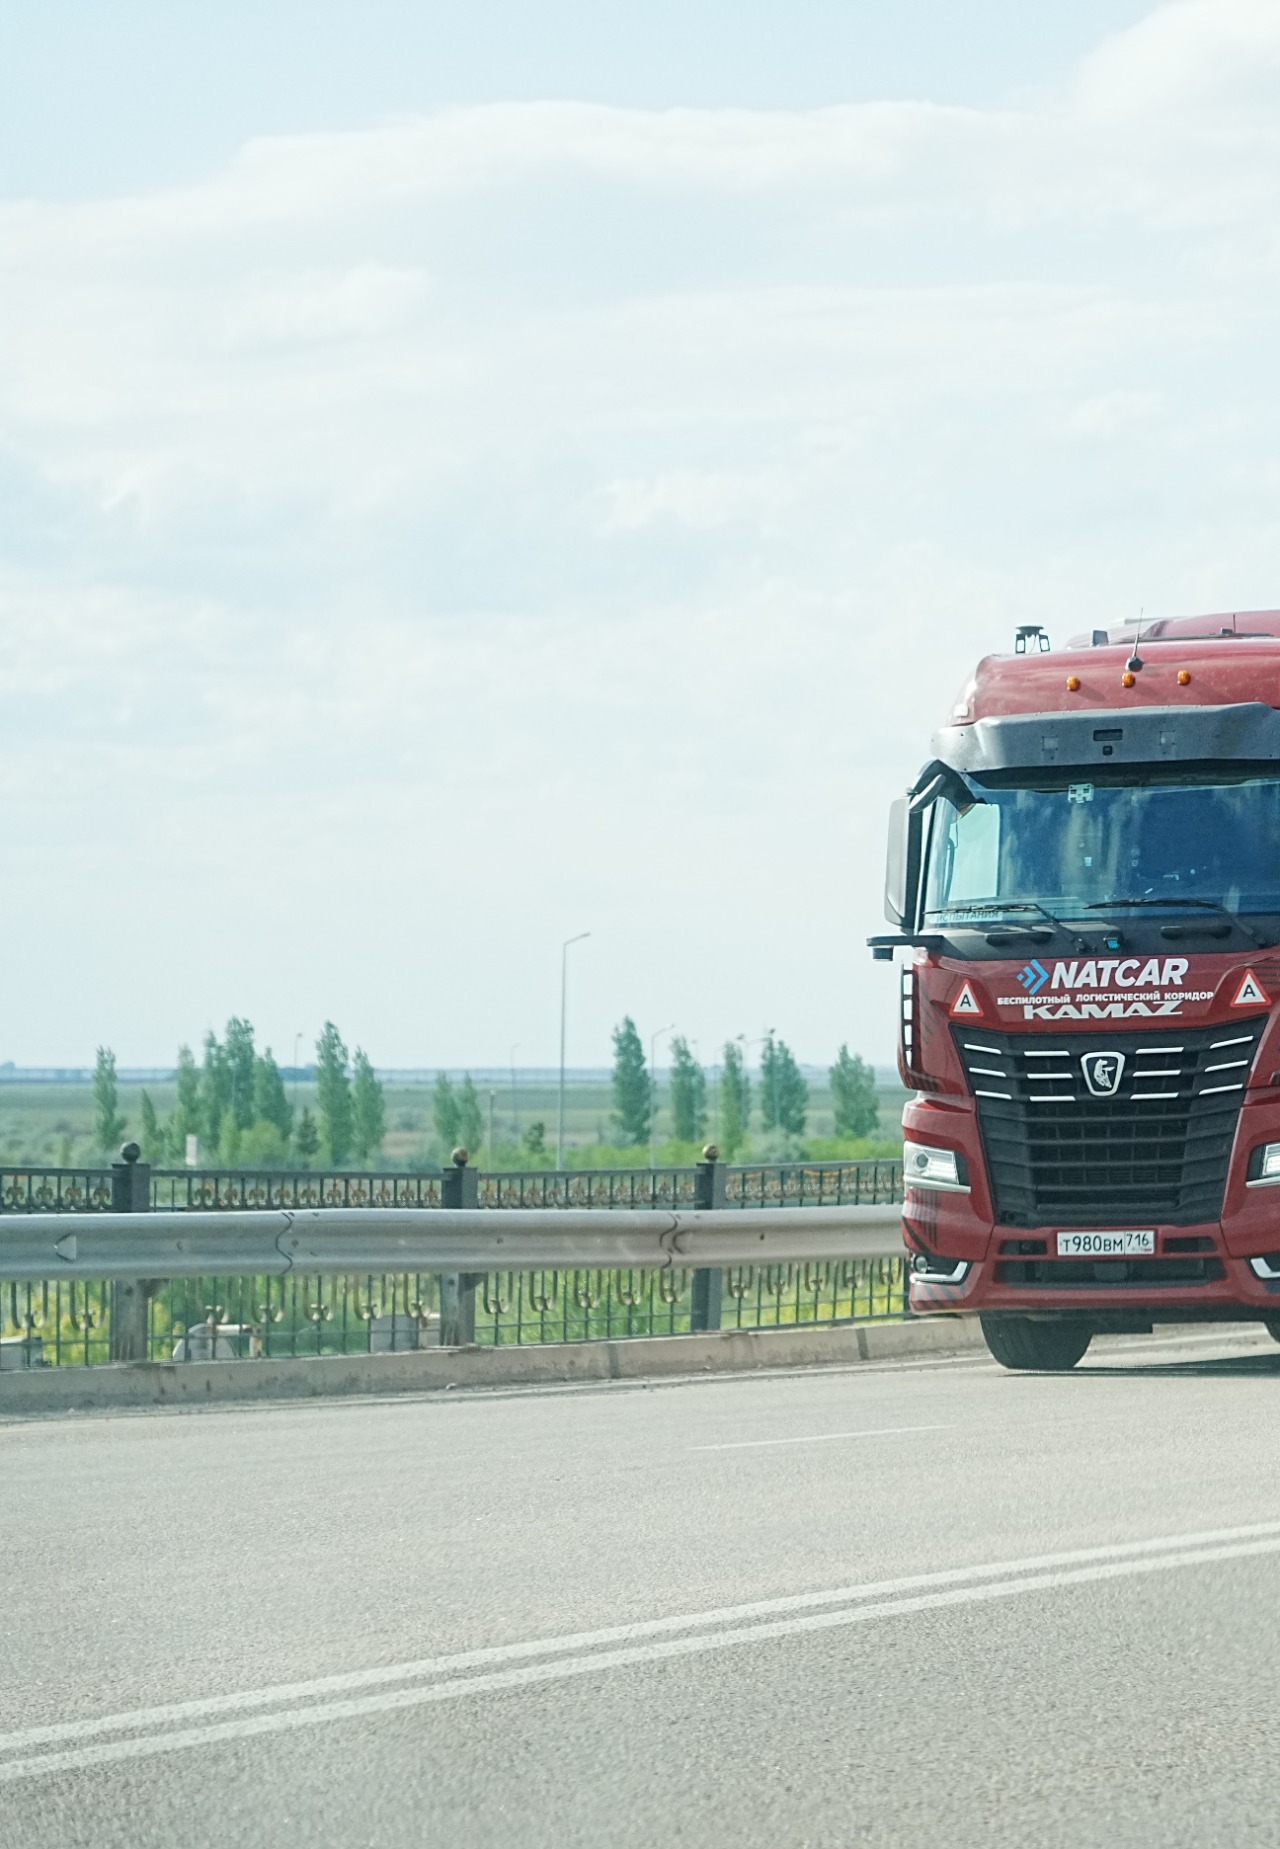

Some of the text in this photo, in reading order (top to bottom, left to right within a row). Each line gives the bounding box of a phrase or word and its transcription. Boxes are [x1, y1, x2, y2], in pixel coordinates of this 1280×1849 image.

[1051, 958, 1189, 989] NATCAR
[997, 990, 1214, 1006] БЕСПИЛОТНЫЙ ЛОГИСТИЧЕСКИЙ КОРИДОР
[1024, 1001, 1183, 1020] KAMAZ
[1126, 1233, 1149, 1247] 716
